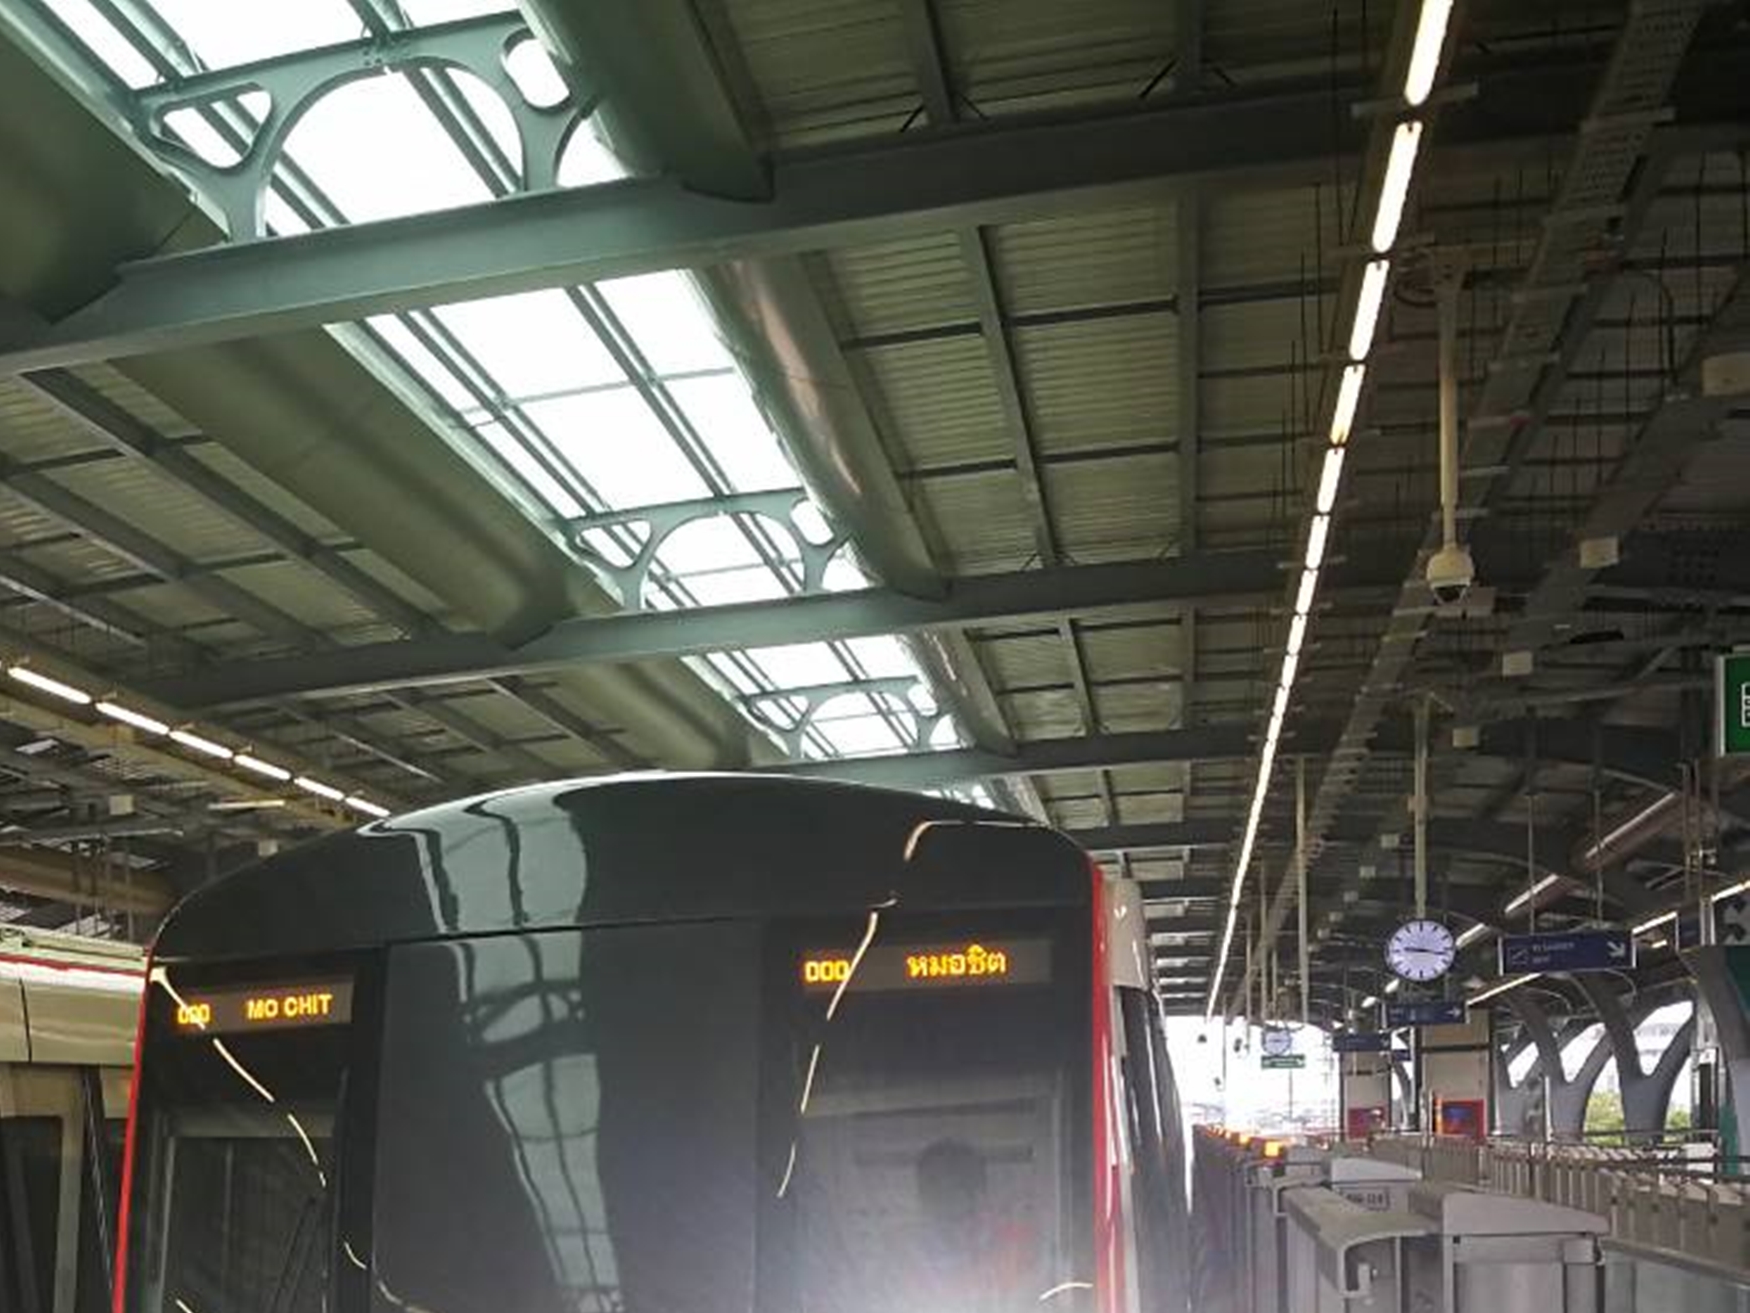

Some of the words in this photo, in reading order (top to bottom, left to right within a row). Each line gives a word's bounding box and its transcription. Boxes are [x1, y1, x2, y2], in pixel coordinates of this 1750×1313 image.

[805, 960, 851, 983] 000
[906, 944, 1007, 978] หมอชิต
[247, 999, 279, 1020] MO
[284, 994, 333, 1018] CHIT
